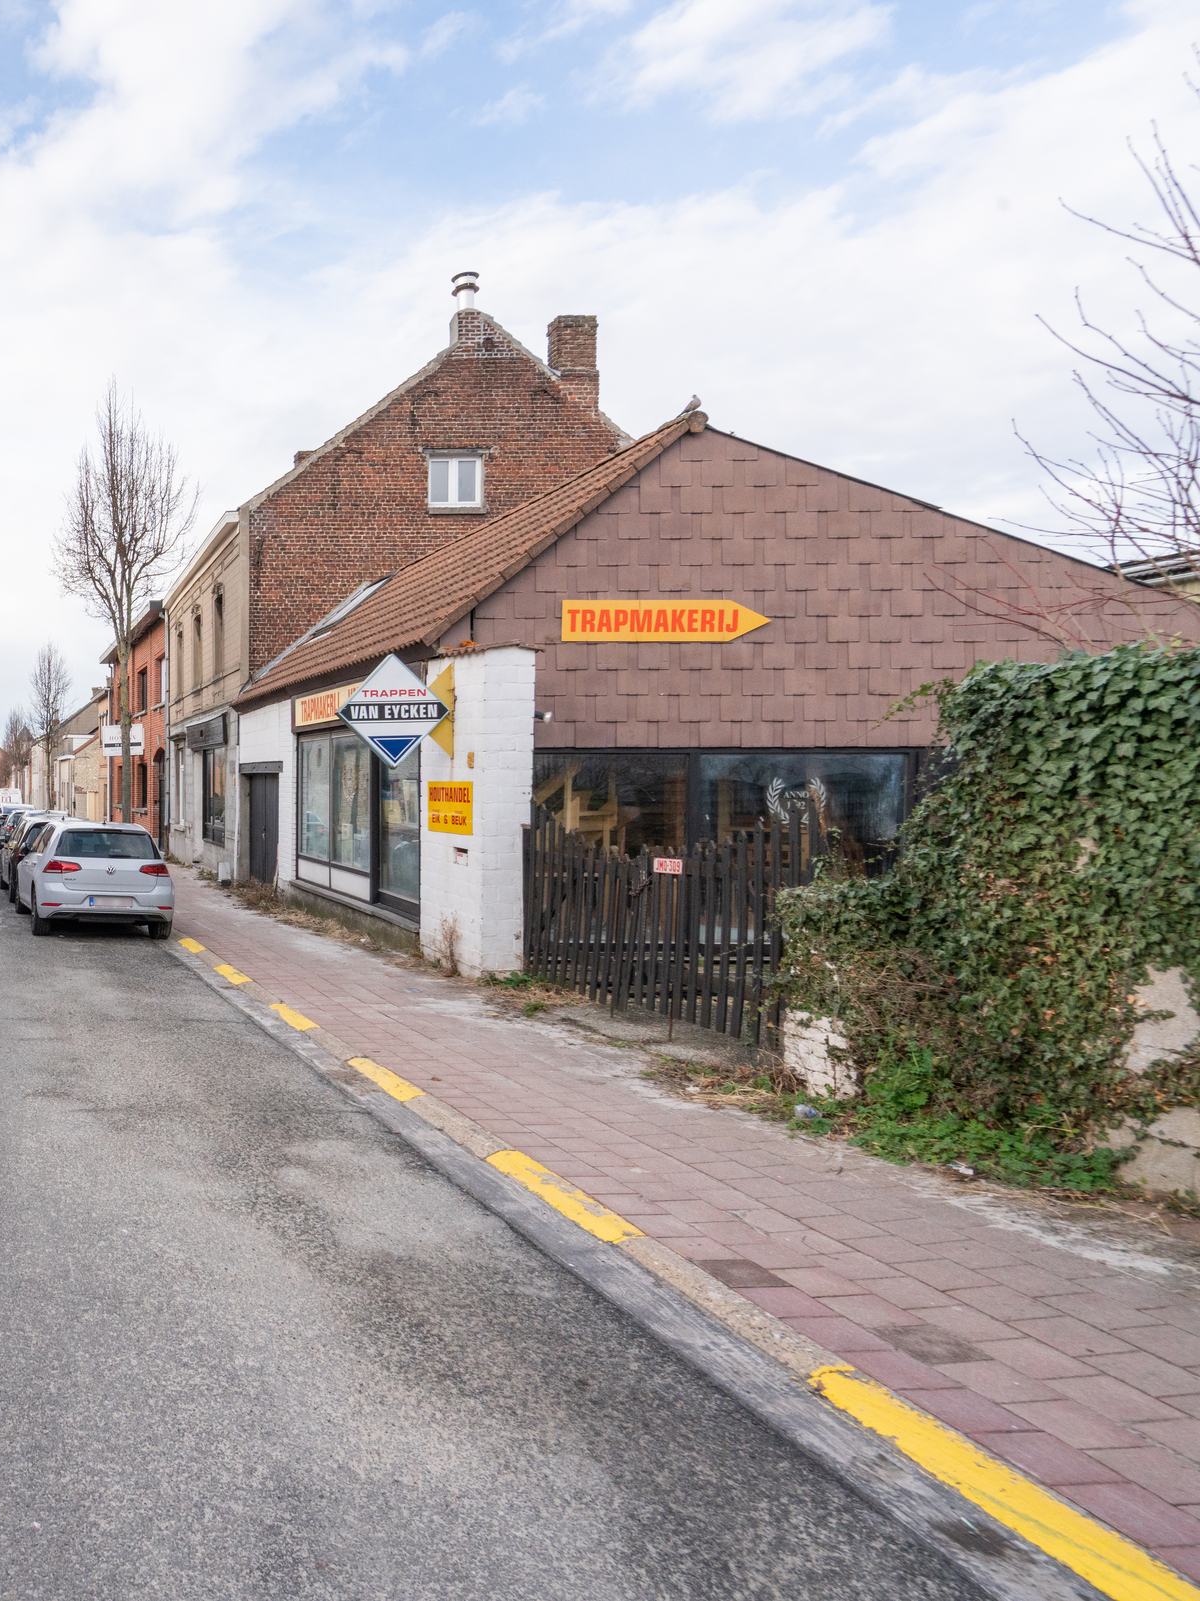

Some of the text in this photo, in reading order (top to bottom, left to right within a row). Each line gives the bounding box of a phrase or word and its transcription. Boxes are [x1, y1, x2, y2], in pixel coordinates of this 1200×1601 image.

[567, 609, 739, 633] TRAPMAKERIJ
[362, 689, 427, 698] TRAPPEN
[350, 704, 438, 719] VAN EYCKEN
[429, 787, 471, 803] HOUTHANDEL
[783, 791, 810, 799] ANNO
[786, 801, 806, 810] 12
[432, 814, 467, 826] EIK & BEUK
